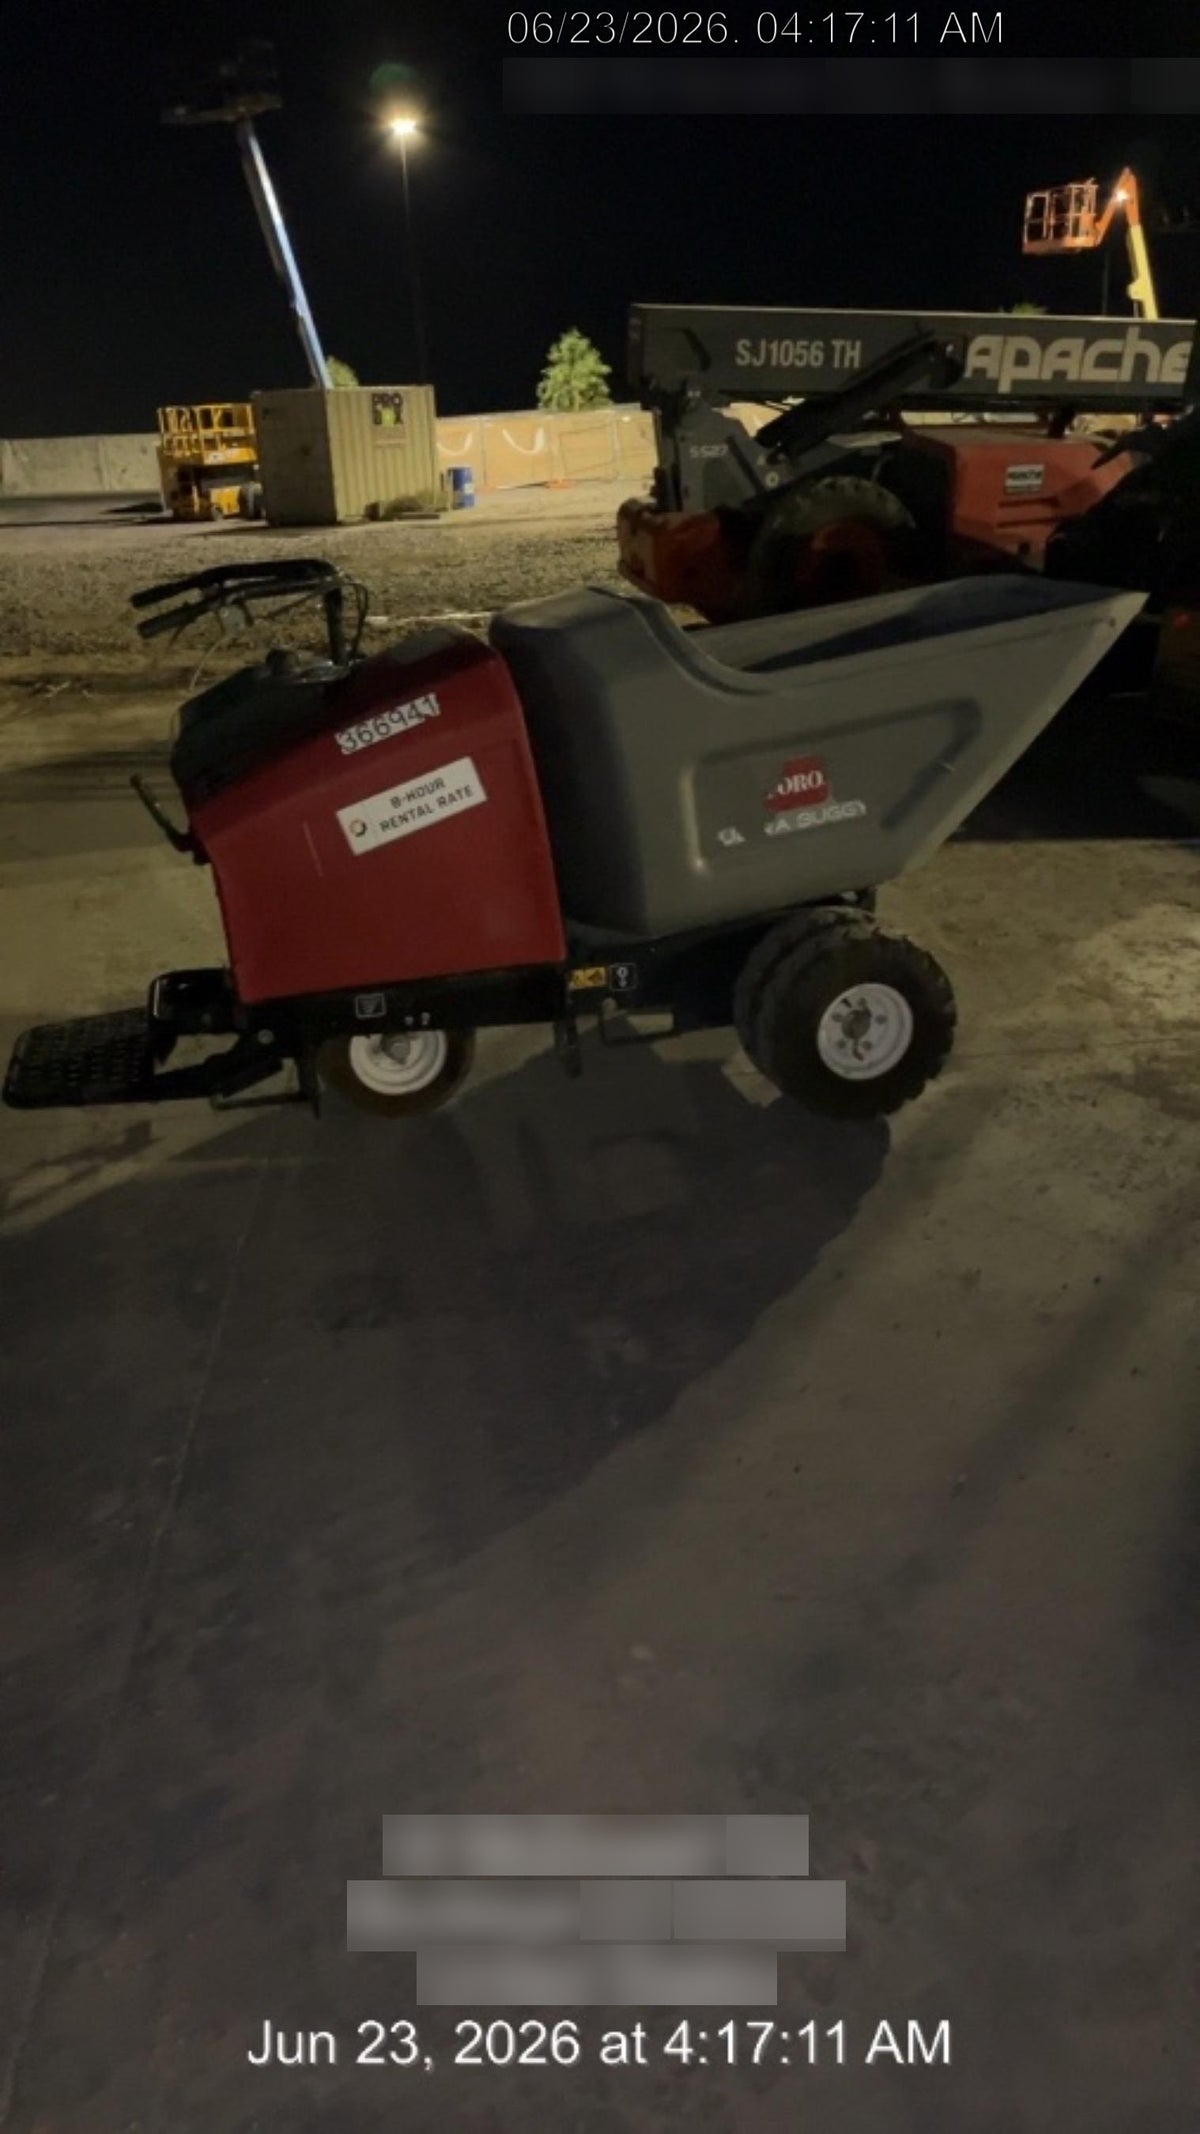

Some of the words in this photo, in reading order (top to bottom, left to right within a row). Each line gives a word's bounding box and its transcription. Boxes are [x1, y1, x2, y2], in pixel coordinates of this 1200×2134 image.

[735, 338, 824, 368] SJ1056
[831, 339, 862, 369] TH
[339, 695, 439, 753] 366941
[390, 776, 447, 808] 8-HOUR
[767, 770, 826, 798] ORO
[379, 803, 435, 832] RENTAL
[436, 784, 475, 809] RATE
